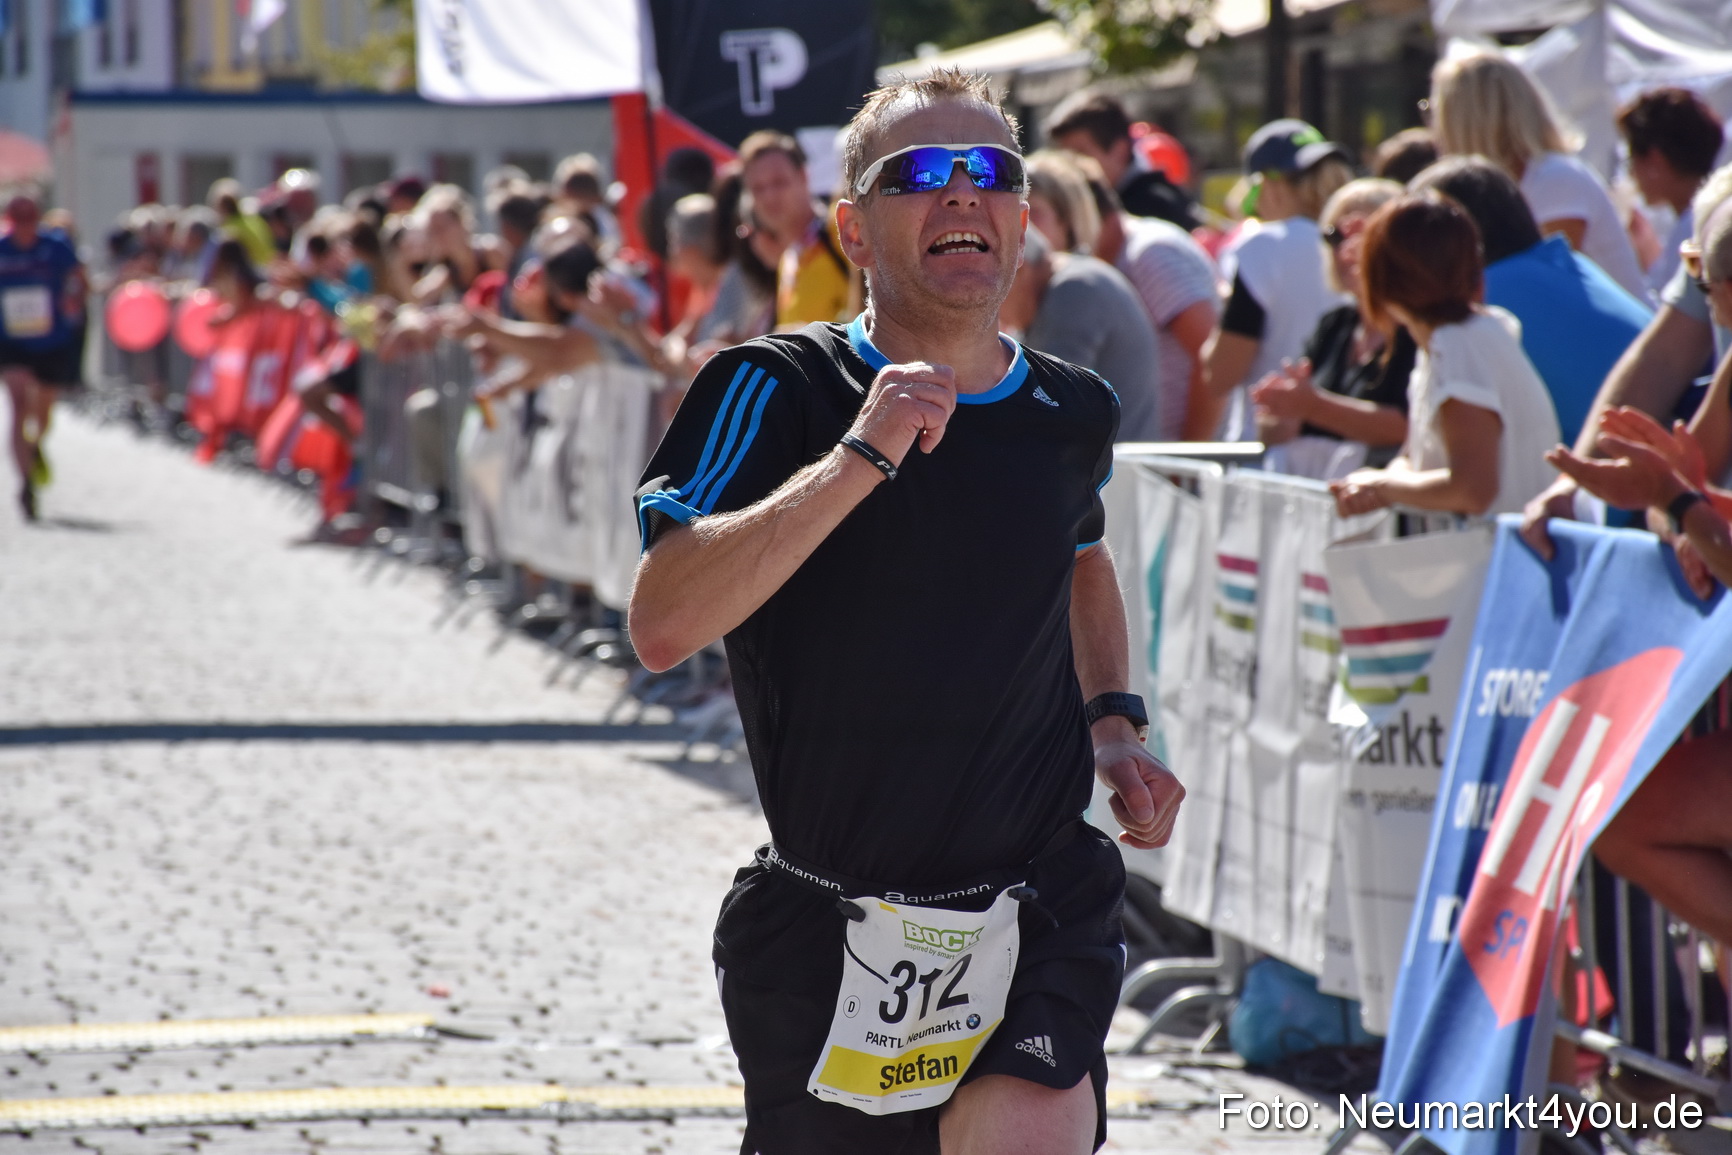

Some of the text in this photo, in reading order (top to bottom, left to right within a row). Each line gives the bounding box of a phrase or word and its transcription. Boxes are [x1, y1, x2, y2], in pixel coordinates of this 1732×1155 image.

[1477, 668, 1549, 718] STORE
[902, 920, 985, 953] BOCK
[904, 941, 928, 953] inspired
[929, 946, 937, 956] by
[879, 953, 970, 1024] 312
[848, 1001, 856, 1013] D
[906, 1020, 962, 1045] Neumarkt
[1015, 1042, 1057, 1067] adidas
[880, 1053, 958, 1091] Stefan
